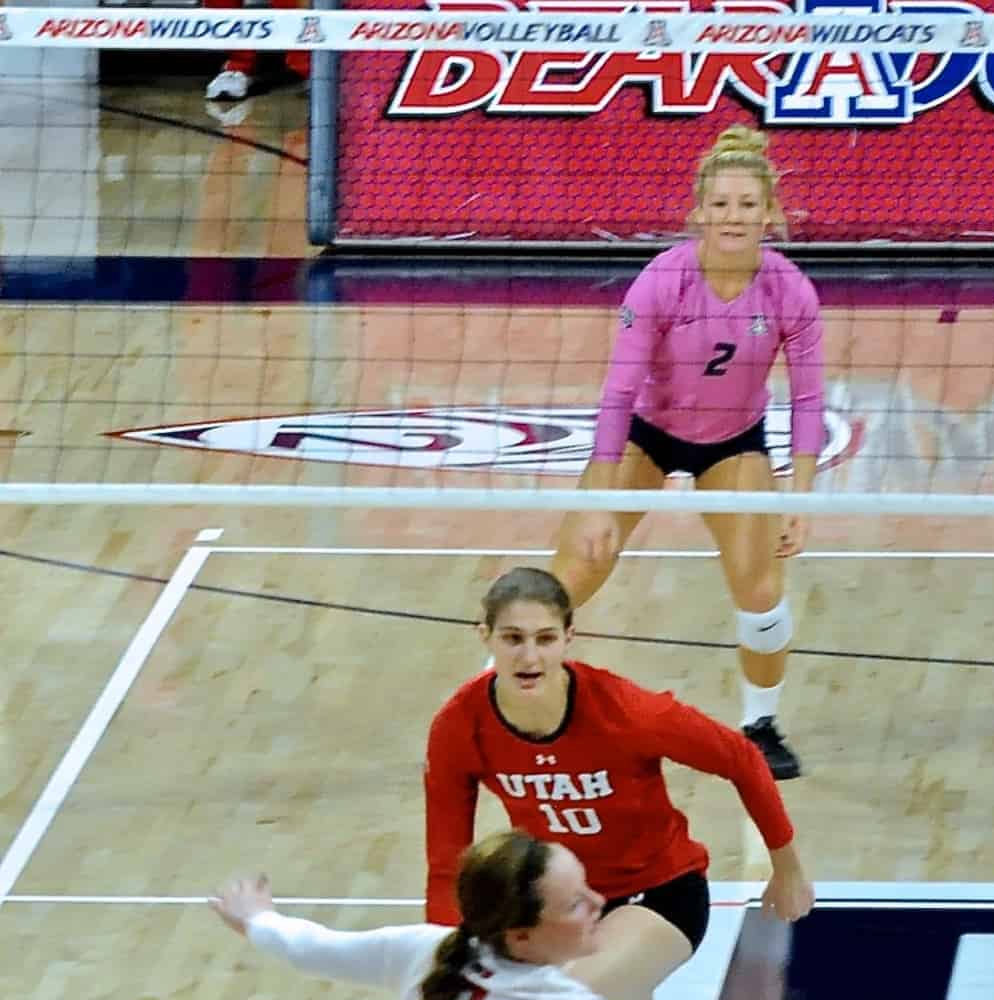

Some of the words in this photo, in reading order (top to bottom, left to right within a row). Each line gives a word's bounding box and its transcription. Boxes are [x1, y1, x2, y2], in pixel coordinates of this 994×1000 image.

[703, 342, 737, 376] 2
[495, 769, 614, 800] UTAH
[538, 803, 602, 834] 10
